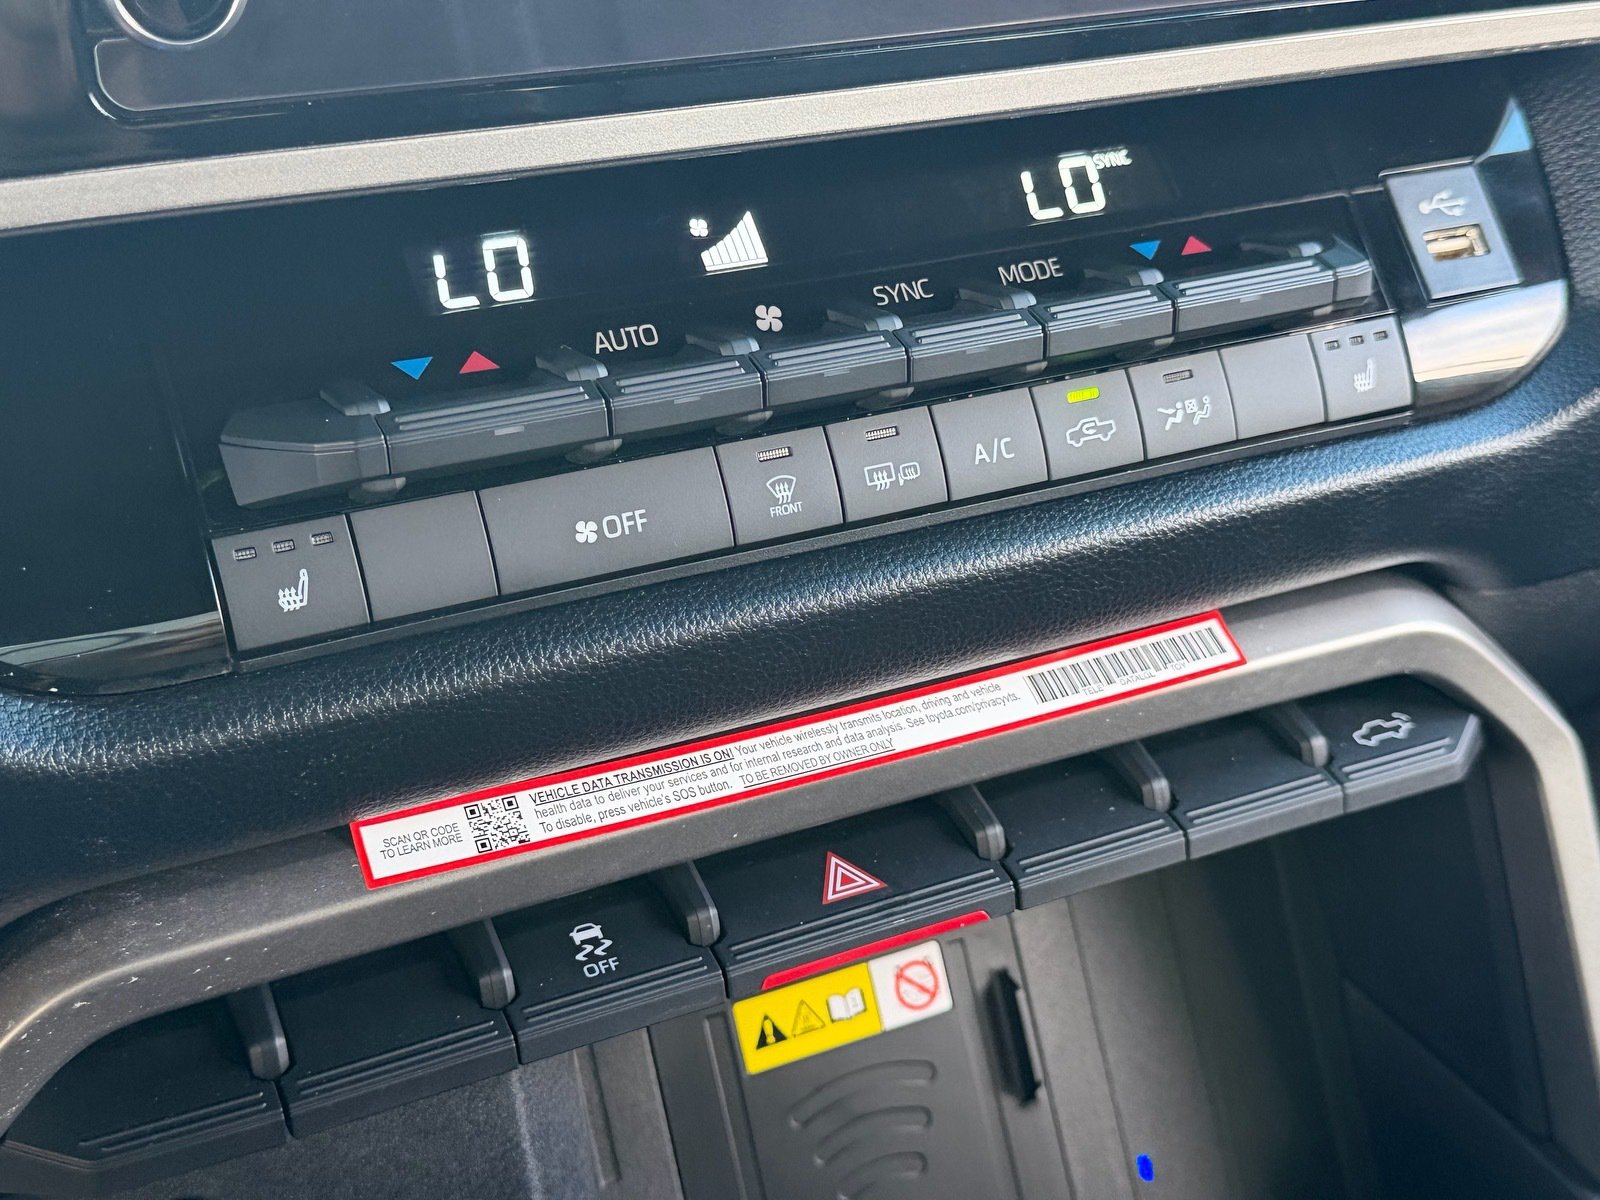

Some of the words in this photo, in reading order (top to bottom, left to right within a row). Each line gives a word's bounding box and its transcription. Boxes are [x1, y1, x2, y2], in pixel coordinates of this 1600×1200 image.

[1093, 149, 1132, 170] SYNC
[998, 257, 1064, 286] MODE
[872, 278, 934, 306] SYNC
[595, 324, 659, 354] AUTO
[974, 437, 1016, 465] A/C
[770, 501, 803, 518] FRONT
[603, 509, 648, 539] OFF
[529, 784, 580, 804] VEHICLE
[582, 777, 614, 793] DATA
[613, 755, 698, 785] TRANSMISSION
[700, 752, 712, 764] IS
[713, 748, 735, 761] ON!
[734, 743, 758, 756] Your
[758, 734, 793, 750] vehicle
[793, 722, 840, 742] wirelessly
[840, 712, 882, 730] transmits
[882, 704, 921, 720] location,
[922, 695, 951, 712] driving
[952, 690, 969, 702] and
[969, 682, 1001, 697] vehicle
[534, 803, 568, 819] health
[570, 796, 592, 811] data
[595, 792, 606, 805] to
[608, 784, 642, 803] deliver
[643, 779, 666, 796] your
[668, 770, 708, 788] services
[711, 764, 729, 777] and
[730, 760, 744, 774] for
[744, 750, 781, 770] internal
[782, 741, 824, 761] research
[825, 735, 843, 749] and
[845, 729, 865, 744] data
[866, 721, 906, 739] analysis.
[906, 716, 925, 728] See
[539, 821, 553, 834] To
[555, 812, 597, 831] disable,
[598, 806, 626, 823] press
[627, 794, 672, 814] vehicle's
[672, 786, 697, 802] SOS
[698, 780, 733, 796] button.
[739, 773, 754, 785] TO
[755, 768, 770, 782] BE
[770, 756, 818, 778] REMOVED
[819, 753, 832, 766] BY
[832, 744, 868, 762] OWNER
[869, 738, 894, 753] ONLY
[380, 848, 395, 860] TO
[397, 841, 431, 856] LEARN
[432, 833, 463, 848] MORE
[383, 834, 411, 848] SCAN
[413, 829, 428, 841] QR
[430, 822, 460, 837] CODE
[583, 956, 620, 978] OFF
